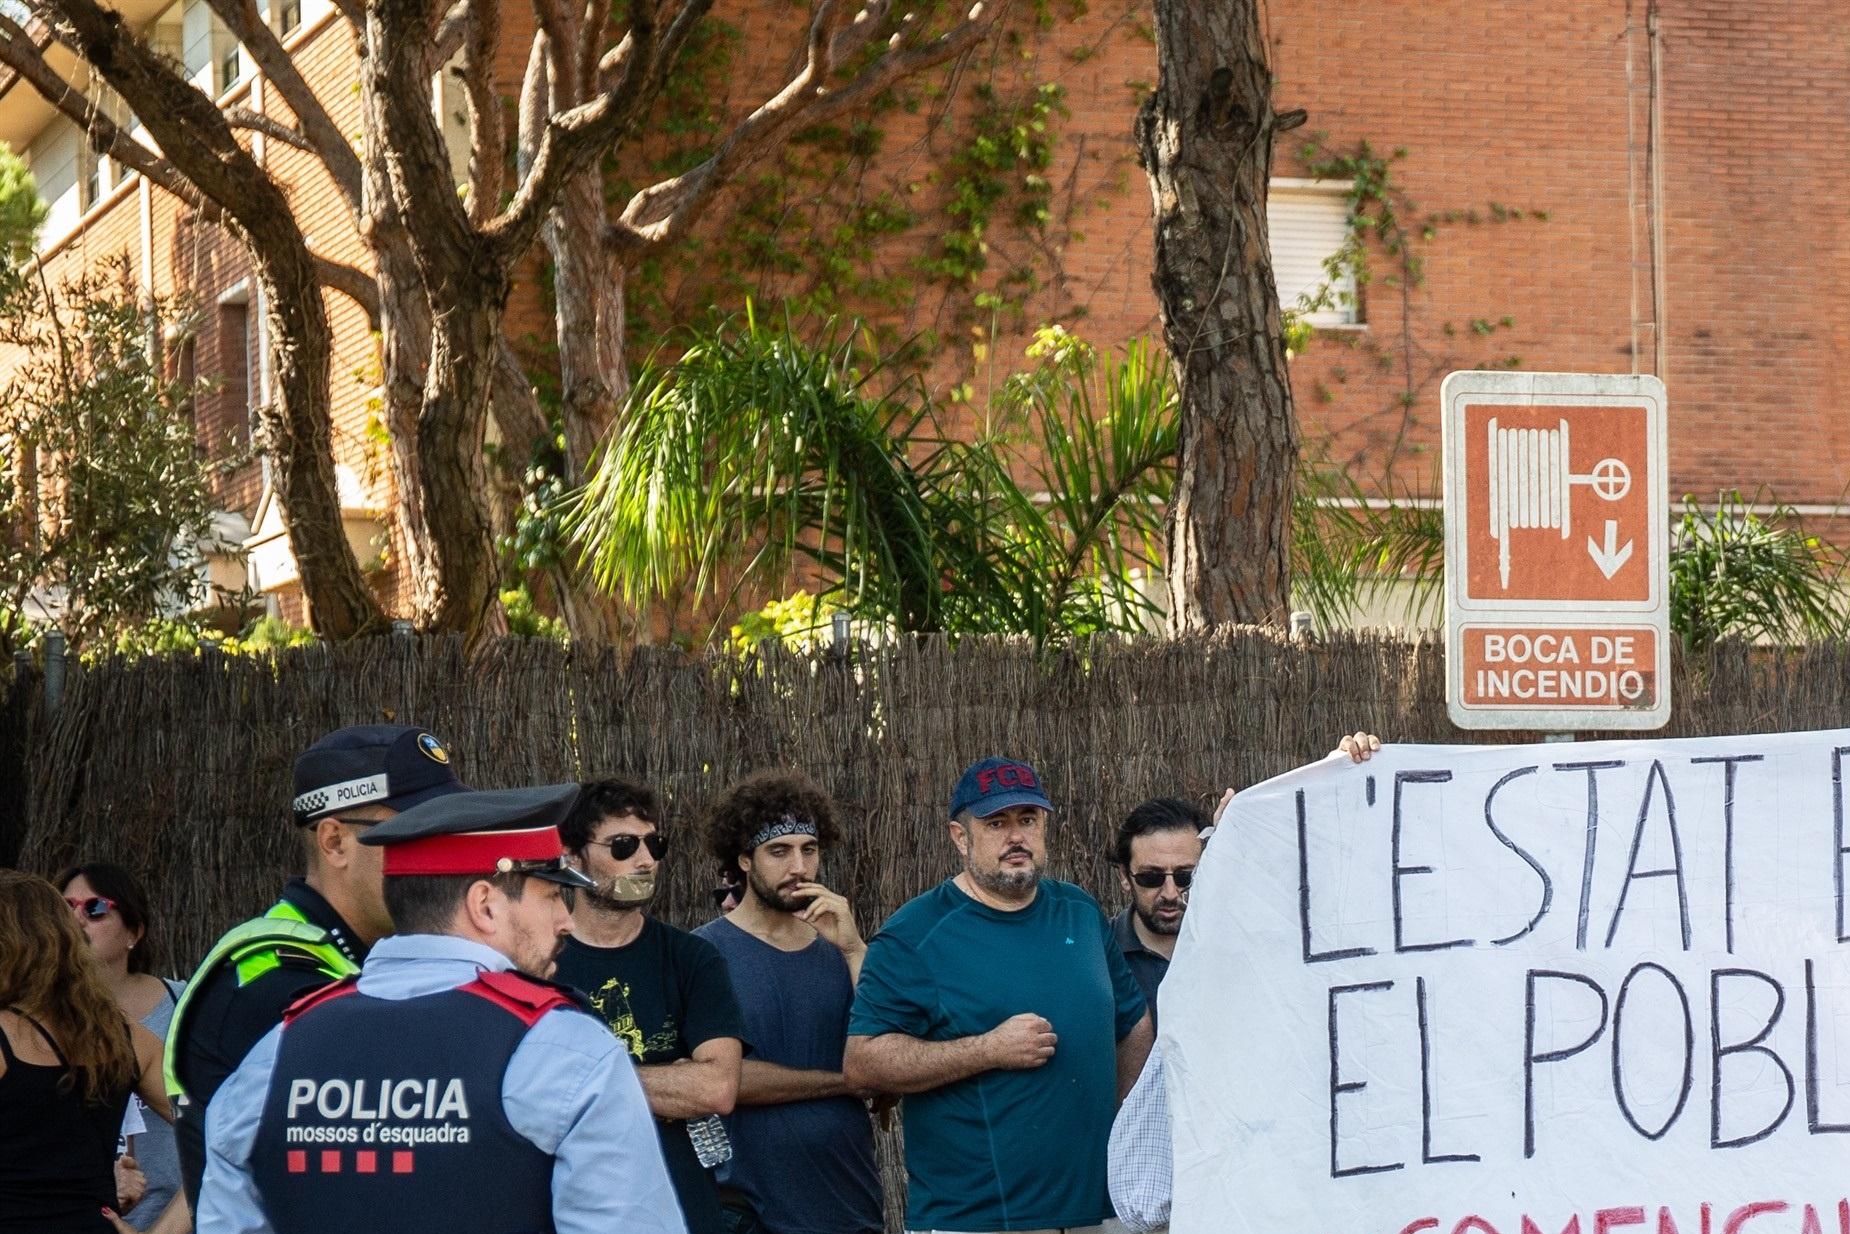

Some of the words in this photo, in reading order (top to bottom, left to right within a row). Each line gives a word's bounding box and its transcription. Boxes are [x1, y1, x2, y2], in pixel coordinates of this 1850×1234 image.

[1484, 634, 1579, 664] BOCA
[1591, 636, 1635, 664] DE
[1477, 669, 1644, 699] INCENDIO
[336, 781, 378, 801] POLICIA
[1295, 753, 1765, 965] L'ESTAT
[1328, 975, 1481, 1179] EL
[287, 1079, 469, 1119] POLICIA
[287, 1125, 358, 1142] mossos
